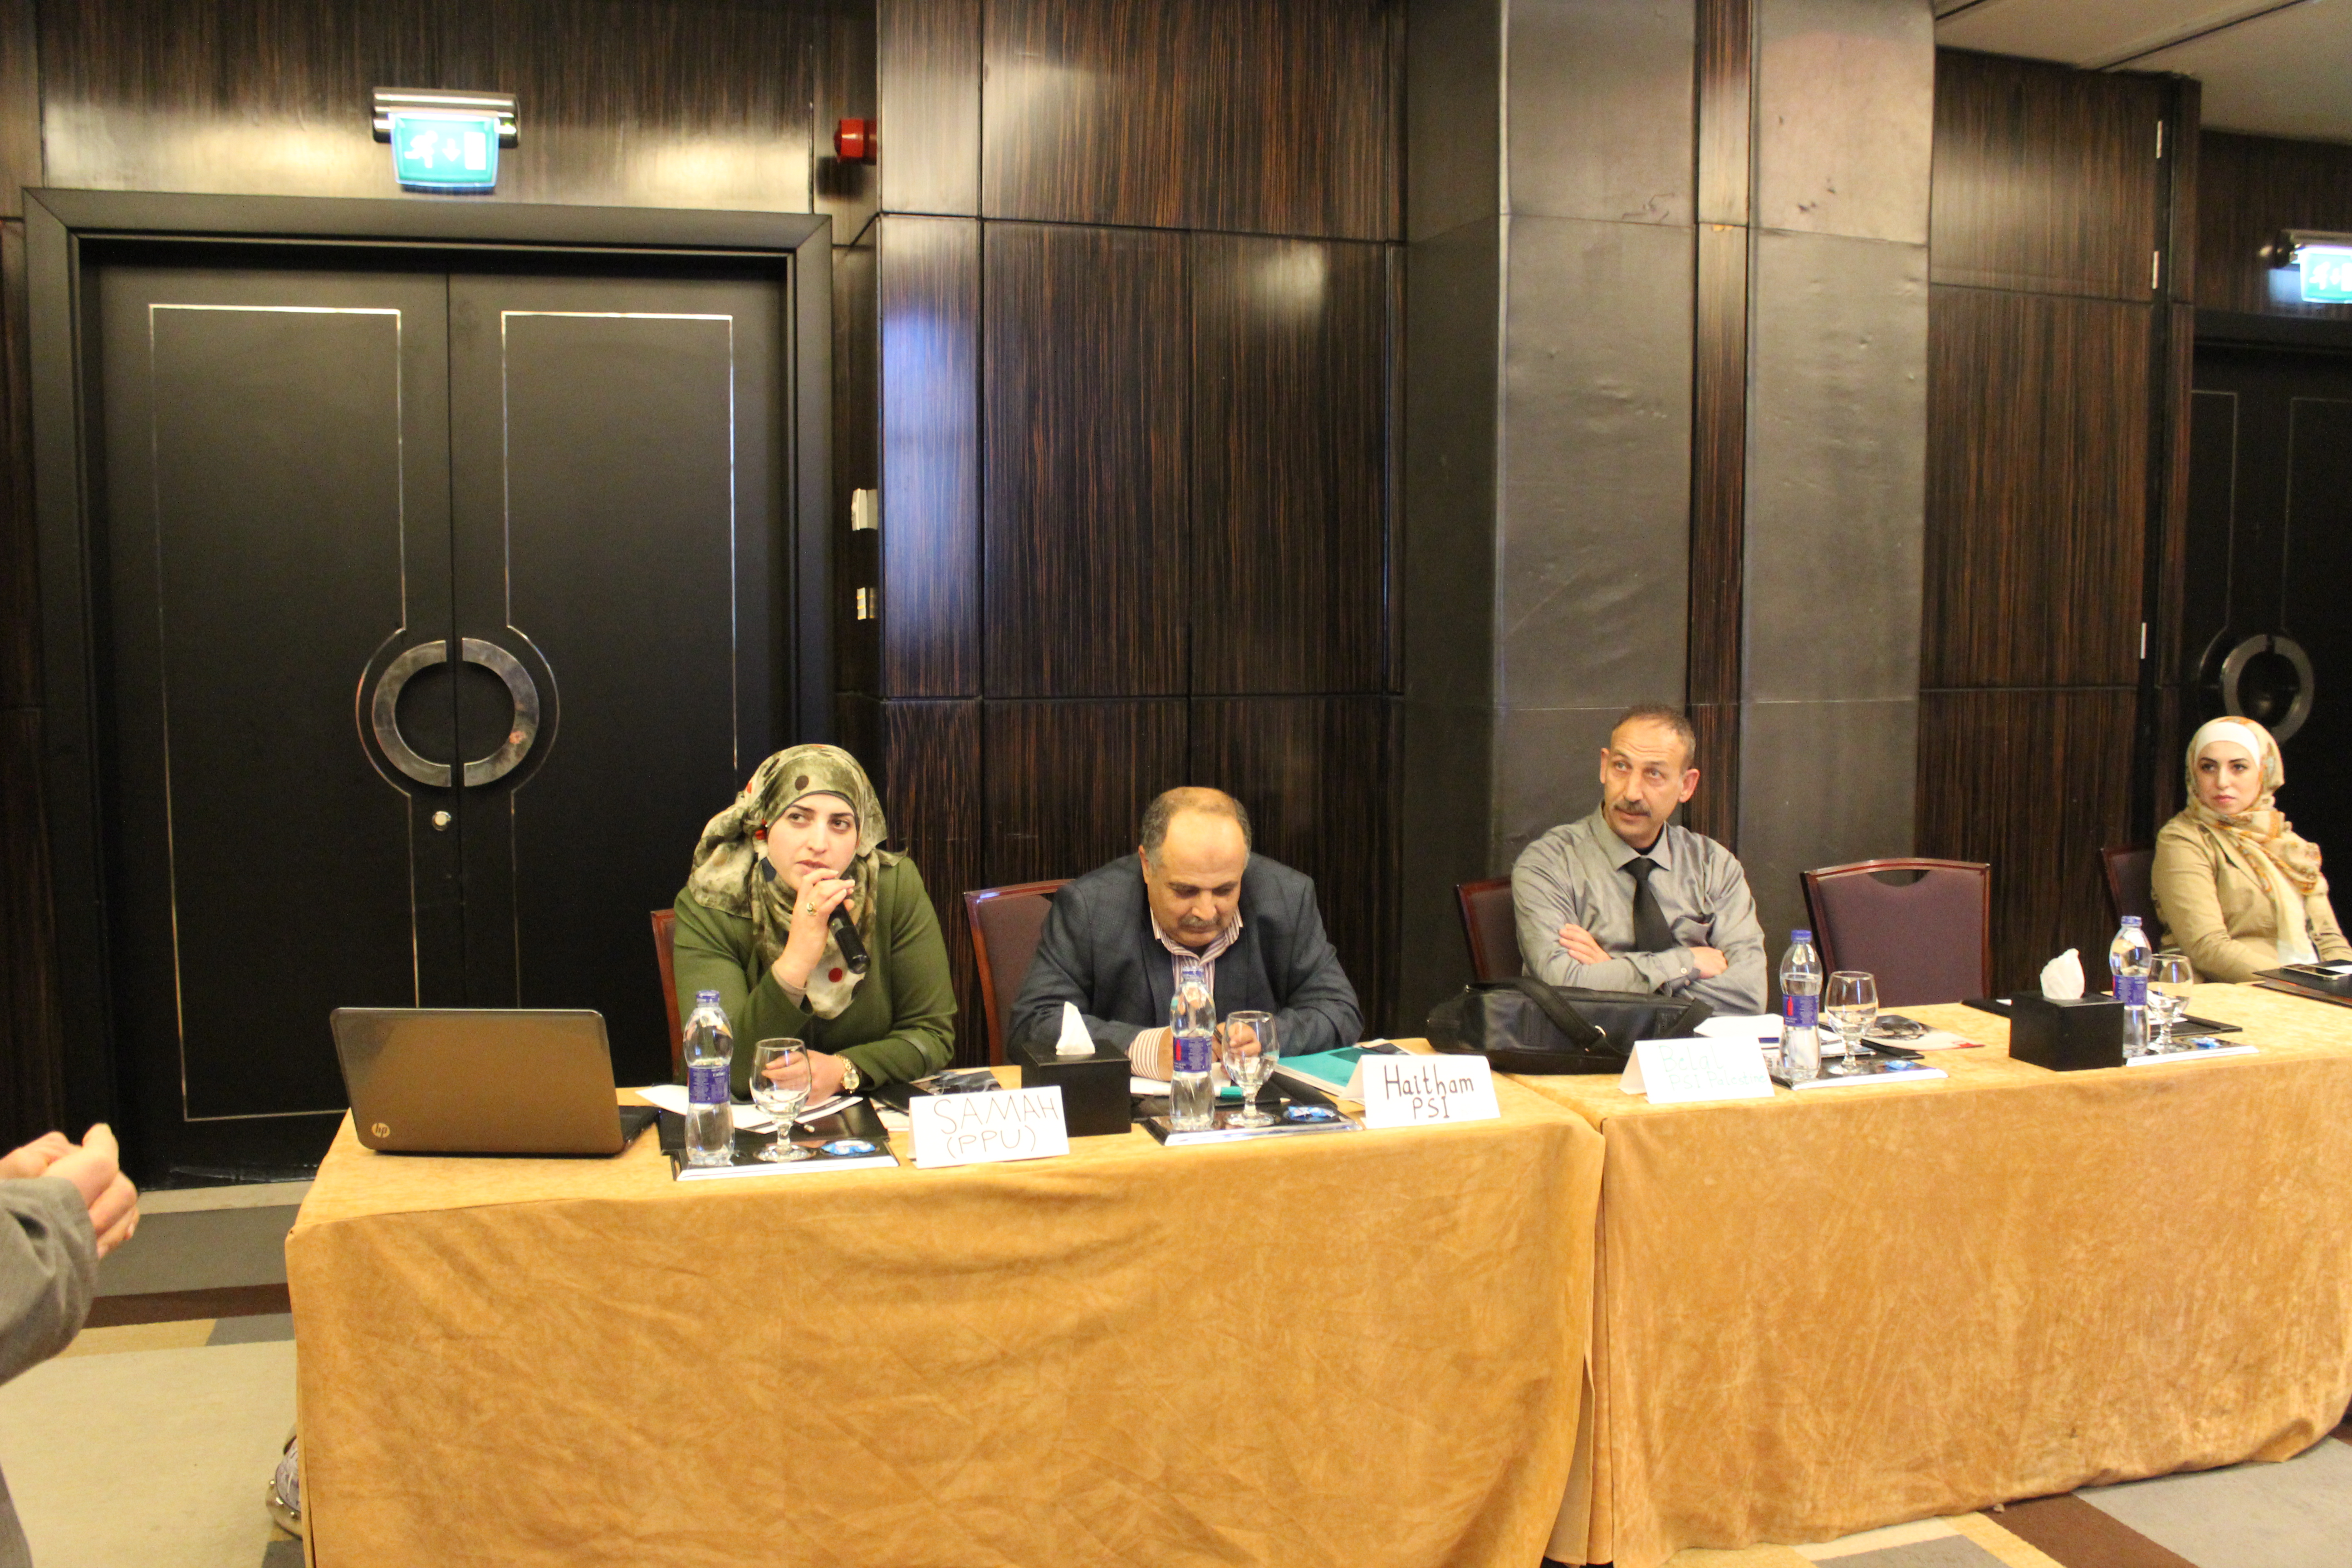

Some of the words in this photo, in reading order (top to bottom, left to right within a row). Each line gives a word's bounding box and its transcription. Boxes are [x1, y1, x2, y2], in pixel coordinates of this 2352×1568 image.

[1659, 1044, 1724, 1073] Belal
[1384, 1063, 1474, 1100] Haitham
[1669, 1074, 1701, 1091] PSI
[1706, 1069, 1768, 1088] Palestine
[934, 1094, 1058, 1134] SAMAH
[1412, 1096, 1450, 1120] PSI
[375, 1123, 388, 1137] hp
[947, 1125, 1036, 1159] (PPU)
